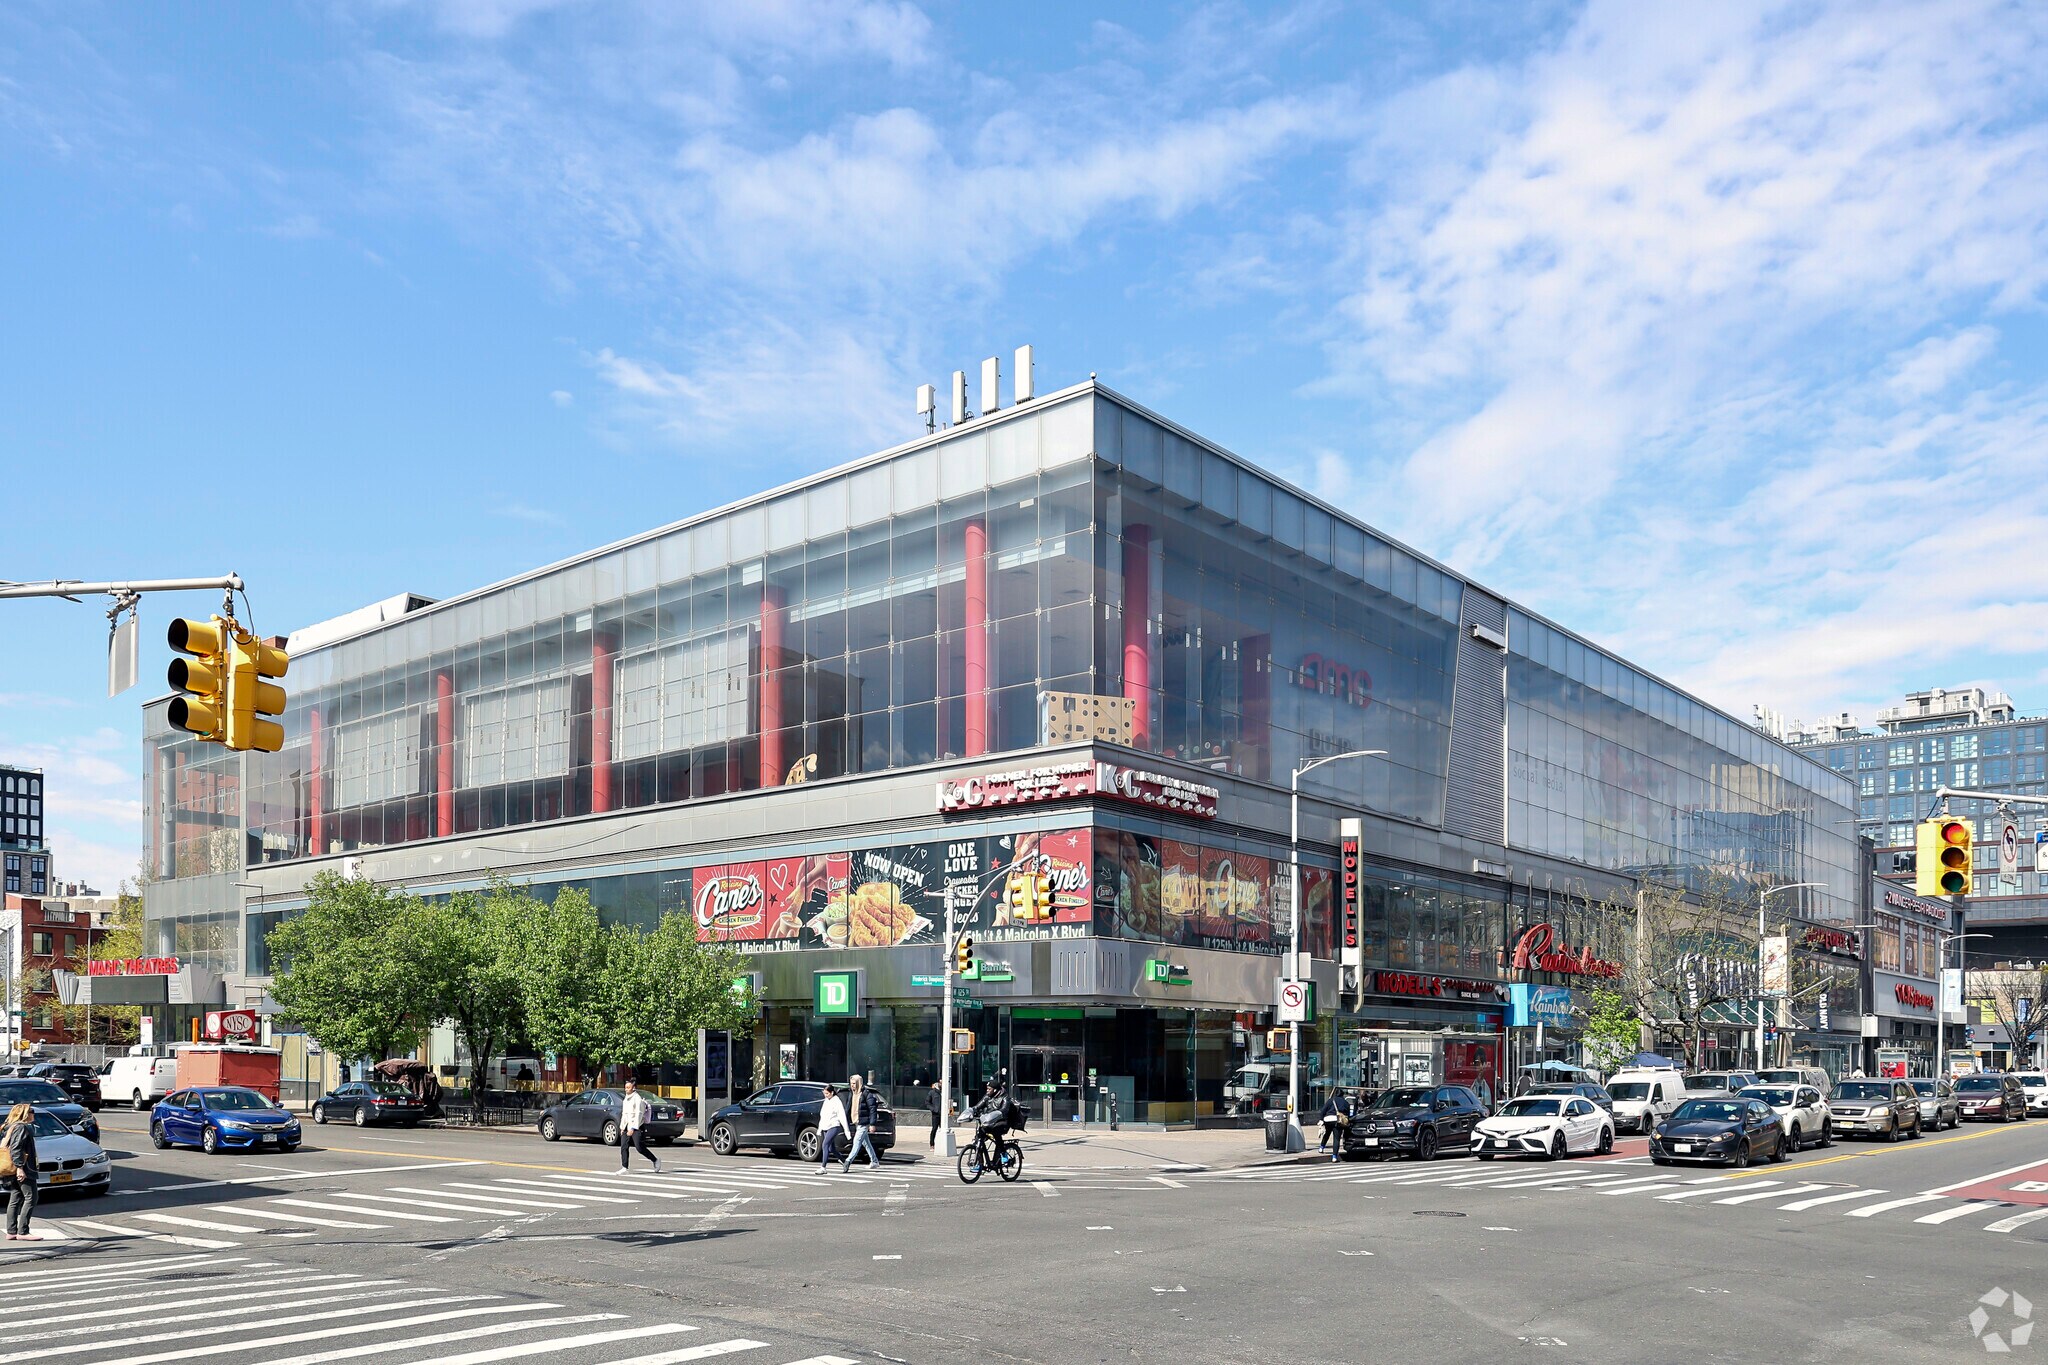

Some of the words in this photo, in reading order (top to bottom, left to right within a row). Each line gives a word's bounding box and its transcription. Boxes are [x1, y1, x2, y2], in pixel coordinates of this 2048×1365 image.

[1299, 652, 1373, 709] amc
[1096, 762, 1141, 798] K&G
[936, 778, 984, 809] K&G
[948, 842, 976, 858] ONE
[863, 851, 892, 873] NOW
[892, 864, 925, 887] OPEN
[944, 856, 978, 873] LOVE
[699, 875, 762, 926] Cane's
[1343, 841, 1357, 946] MODELLS
[995, 928, 1003, 941] &
[1004, 926, 1049, 941] Malcolm
[1050, 925, 1059, 939] X
[1060, 924, 1086, 939] Blvd
[742, 940, 774, 953] Malcolm
[775, 940, 781, 952] X
[782, 939, 800, 951] Blvd
[1203, 937, 1210, 948] W
[1211, 938, 1233, 949] 125th
[88, 959, 122, 976] MAGIC
[123, 957, 179, 975] THEATRES
[980, 961, 1008, 972] Bank
[1156, 964, 1166, 977] TD
[823, 982, 846, 1005] TD
[957, 988, 966, 997] 125
[1377, 972, 1441, 997] MODELL'S
[1819, 992, 1829, 1010] OLD
[226, 1015, 249, 1031] NYSC
[1819, 1010, 1829, 1030] NAVY
